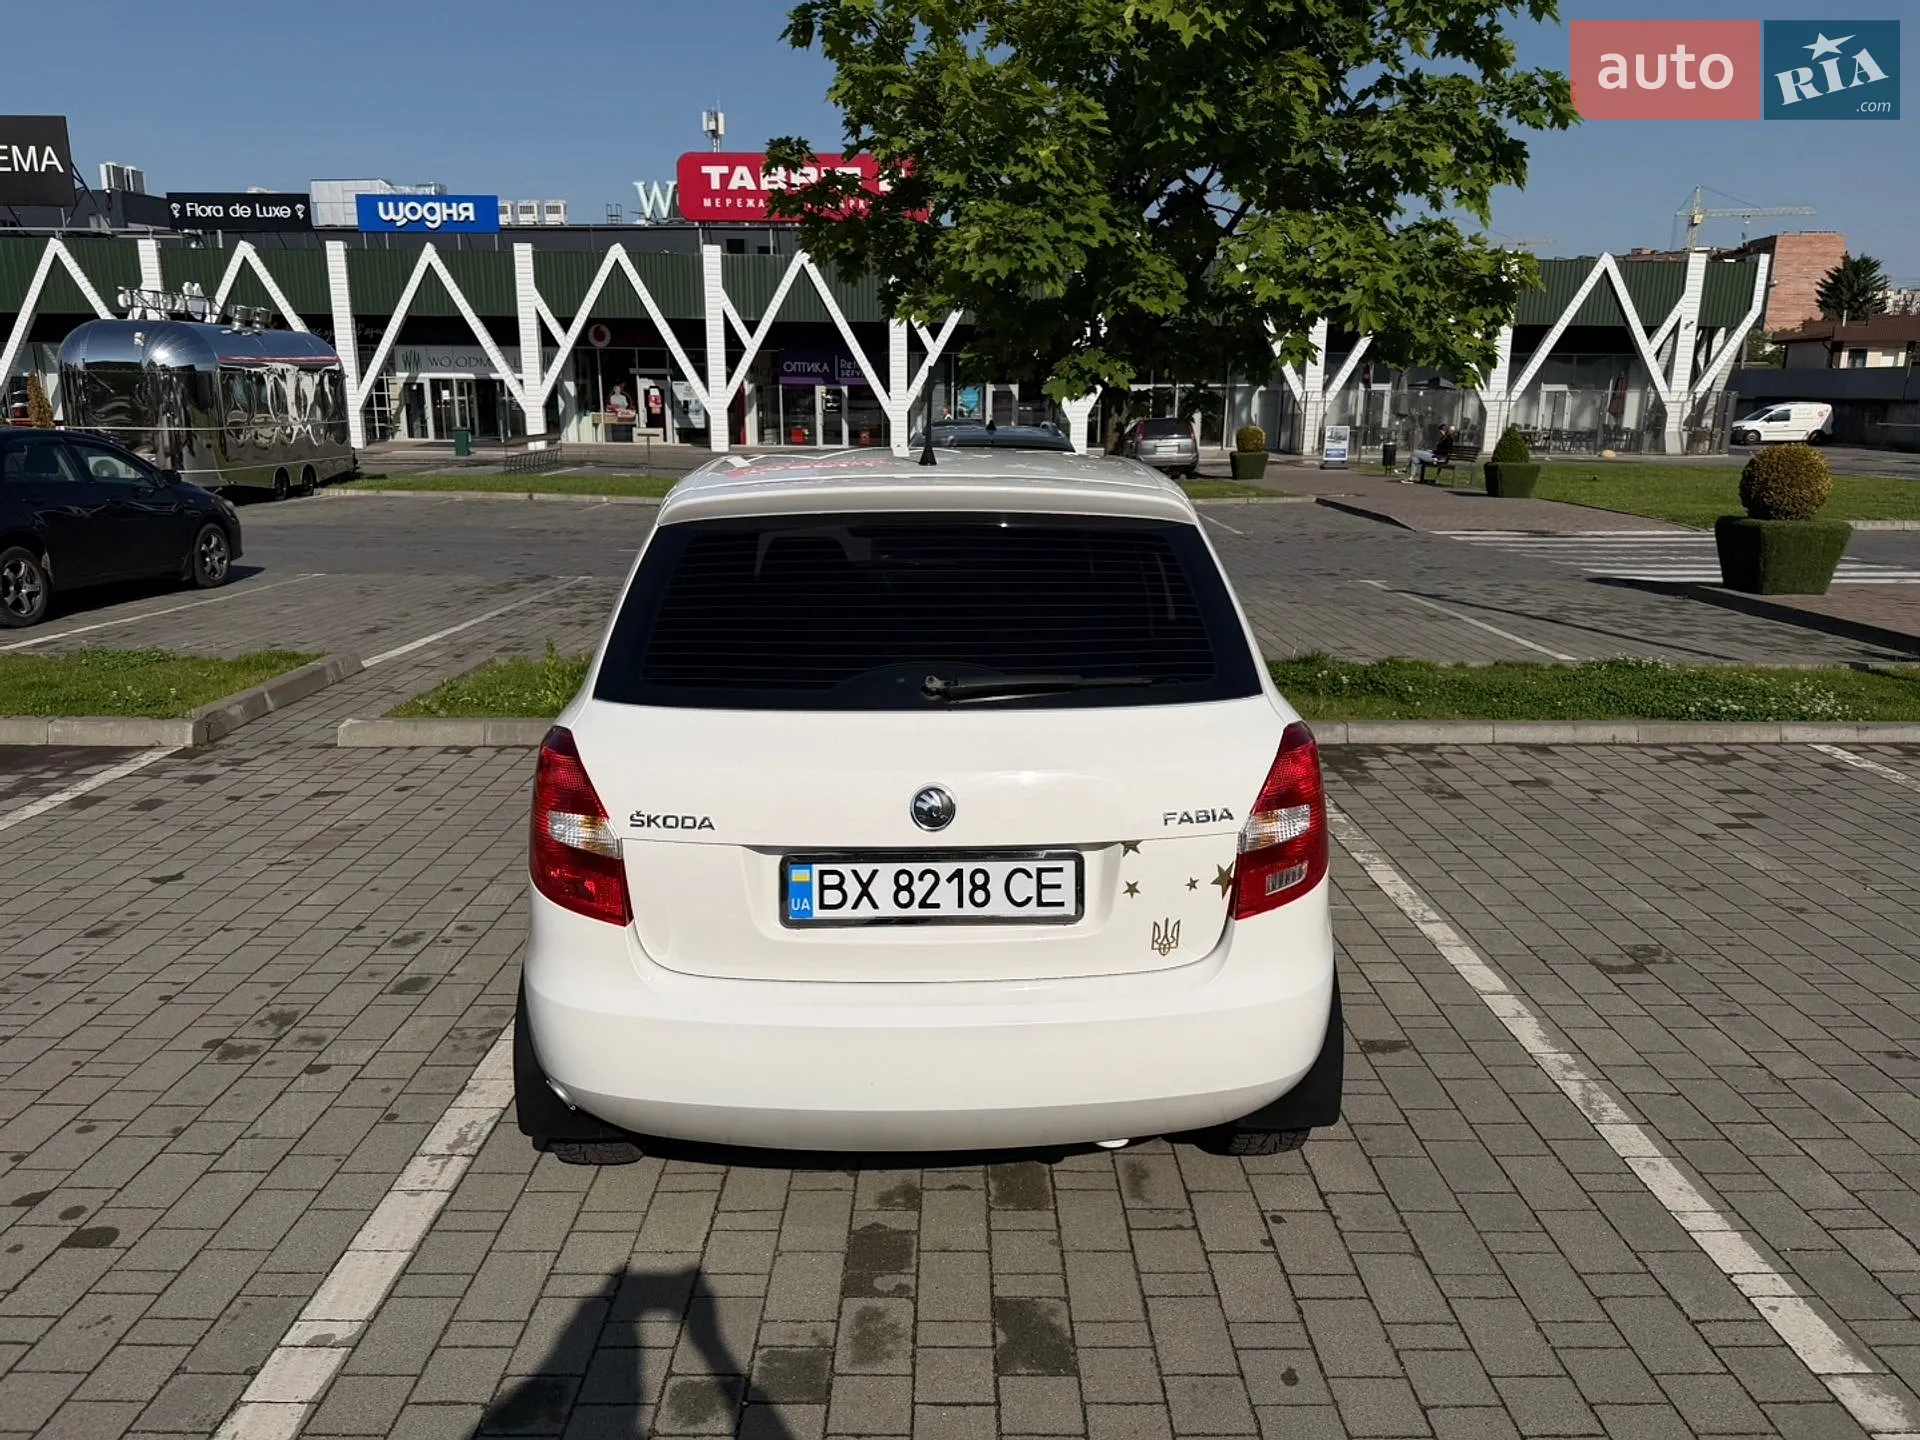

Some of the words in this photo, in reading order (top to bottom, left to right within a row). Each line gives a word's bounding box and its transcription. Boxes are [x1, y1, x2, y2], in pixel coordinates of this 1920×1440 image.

[701, 165, 861, 190] ТАВР
[632, 180, 679, 219] W
[703, 198, 766, 208] МЕРЕЖА
[185, 202, 224, 218] Flora
[229, 203, 251, 218] de
[255, 203, 291, 218] Luxe
[783, 361, 830, 373] ОПТИКА
[629, 810, 716, 831] ŠKODA
[1162, 807, 1234, 827] FABIA
[818, 868, 879, 910] BX
[893, 867, 991, 910] 8218
[1004, 866, 1065, 908] CE
[791, 898, 811, 911] UA
